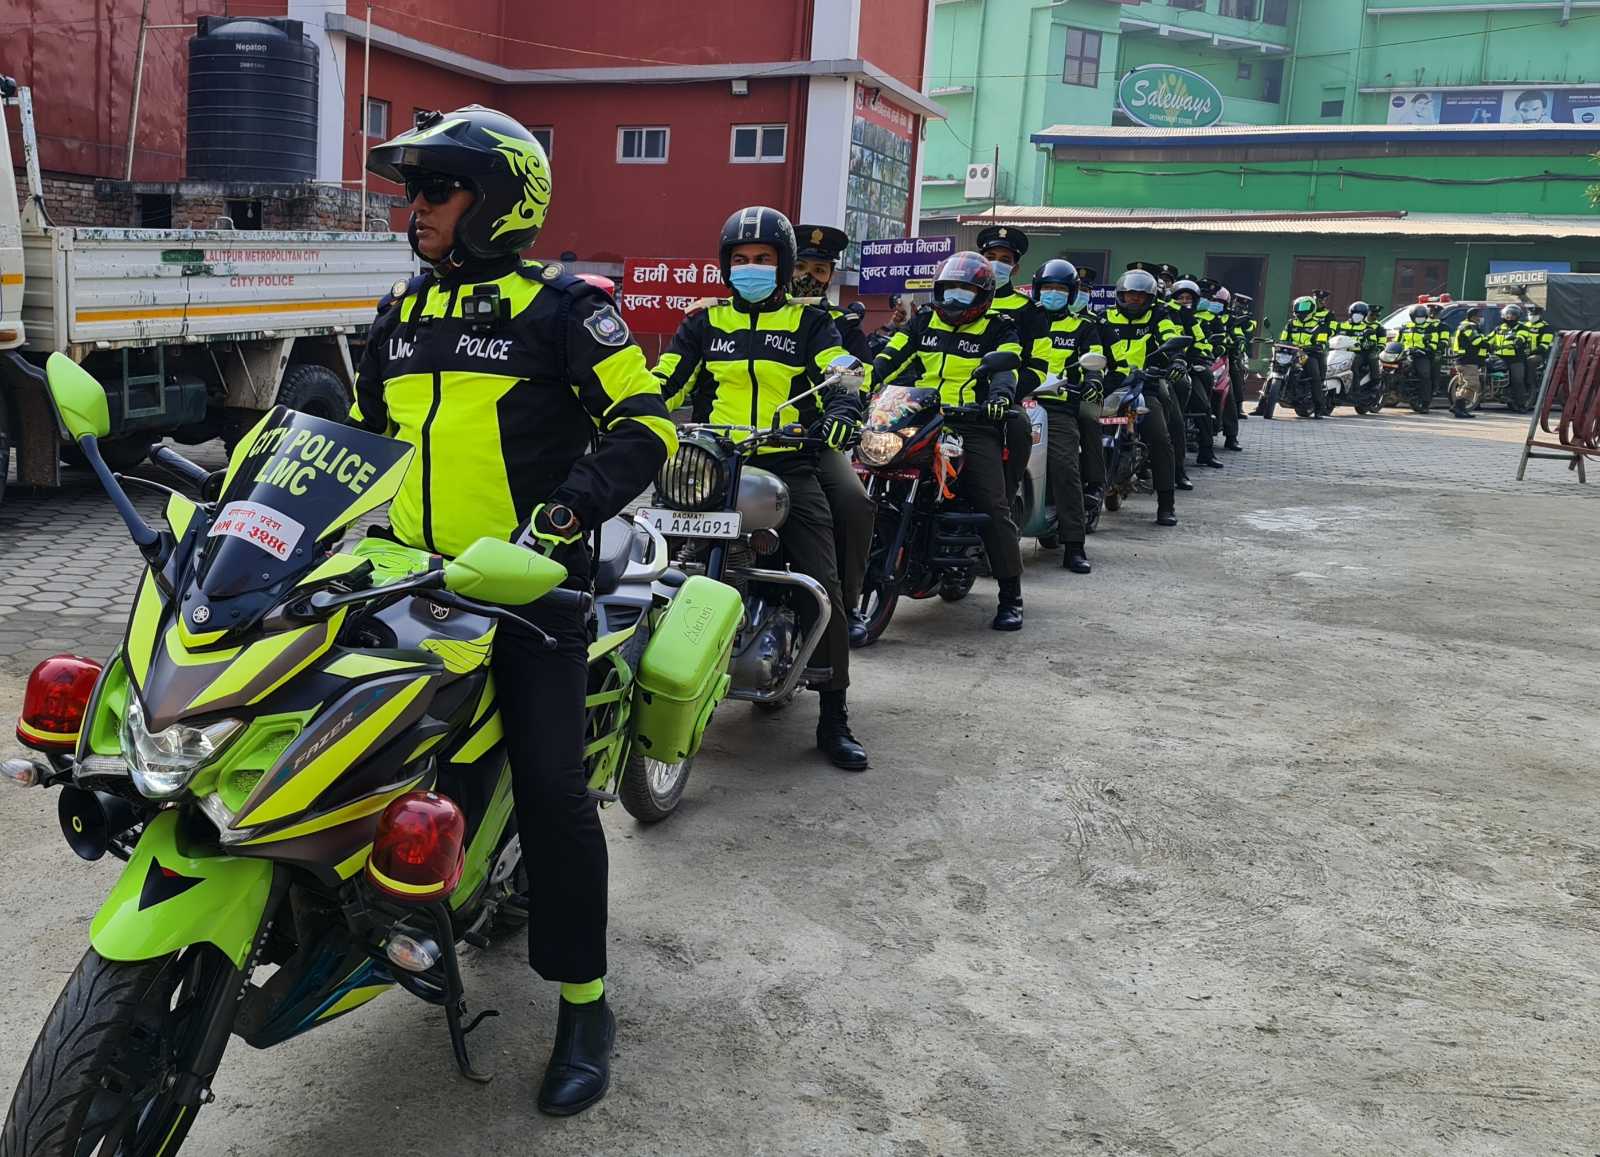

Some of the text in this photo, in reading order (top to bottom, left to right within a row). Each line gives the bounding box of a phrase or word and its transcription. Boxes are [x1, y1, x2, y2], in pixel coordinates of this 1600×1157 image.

[1132, 79, 1211, 120] Saleways
[245, 249, 301, 262] METROPOLITAN
[304, 249, 320, 262] CITY
[230, 275, 294, 288] CITY POLICE
[633, 263, 669, 283] हामी
[673, 263, 699, 284] सबै
[862, 266, 887, 280] सुन्दर
[889, 265, 912, 277] नगर
[1488, 271, 1544, 285] LMC POLICE
[623, 294, 662, 310] सुन्दर
[456, 334, 513, 360] POLICE
[710, 334, 796, 354] LMC POLICE
[921, 335, 980, 353] LMC POLICE
[1053, 336, 1076, 347] POLICE
[249, 427, 377, 494] CITY POLICE
[253, 455, 317, 496] LMC
[671, 511, 704, 519] BAGMATI
[293, 711, 354, 770] FAZER
